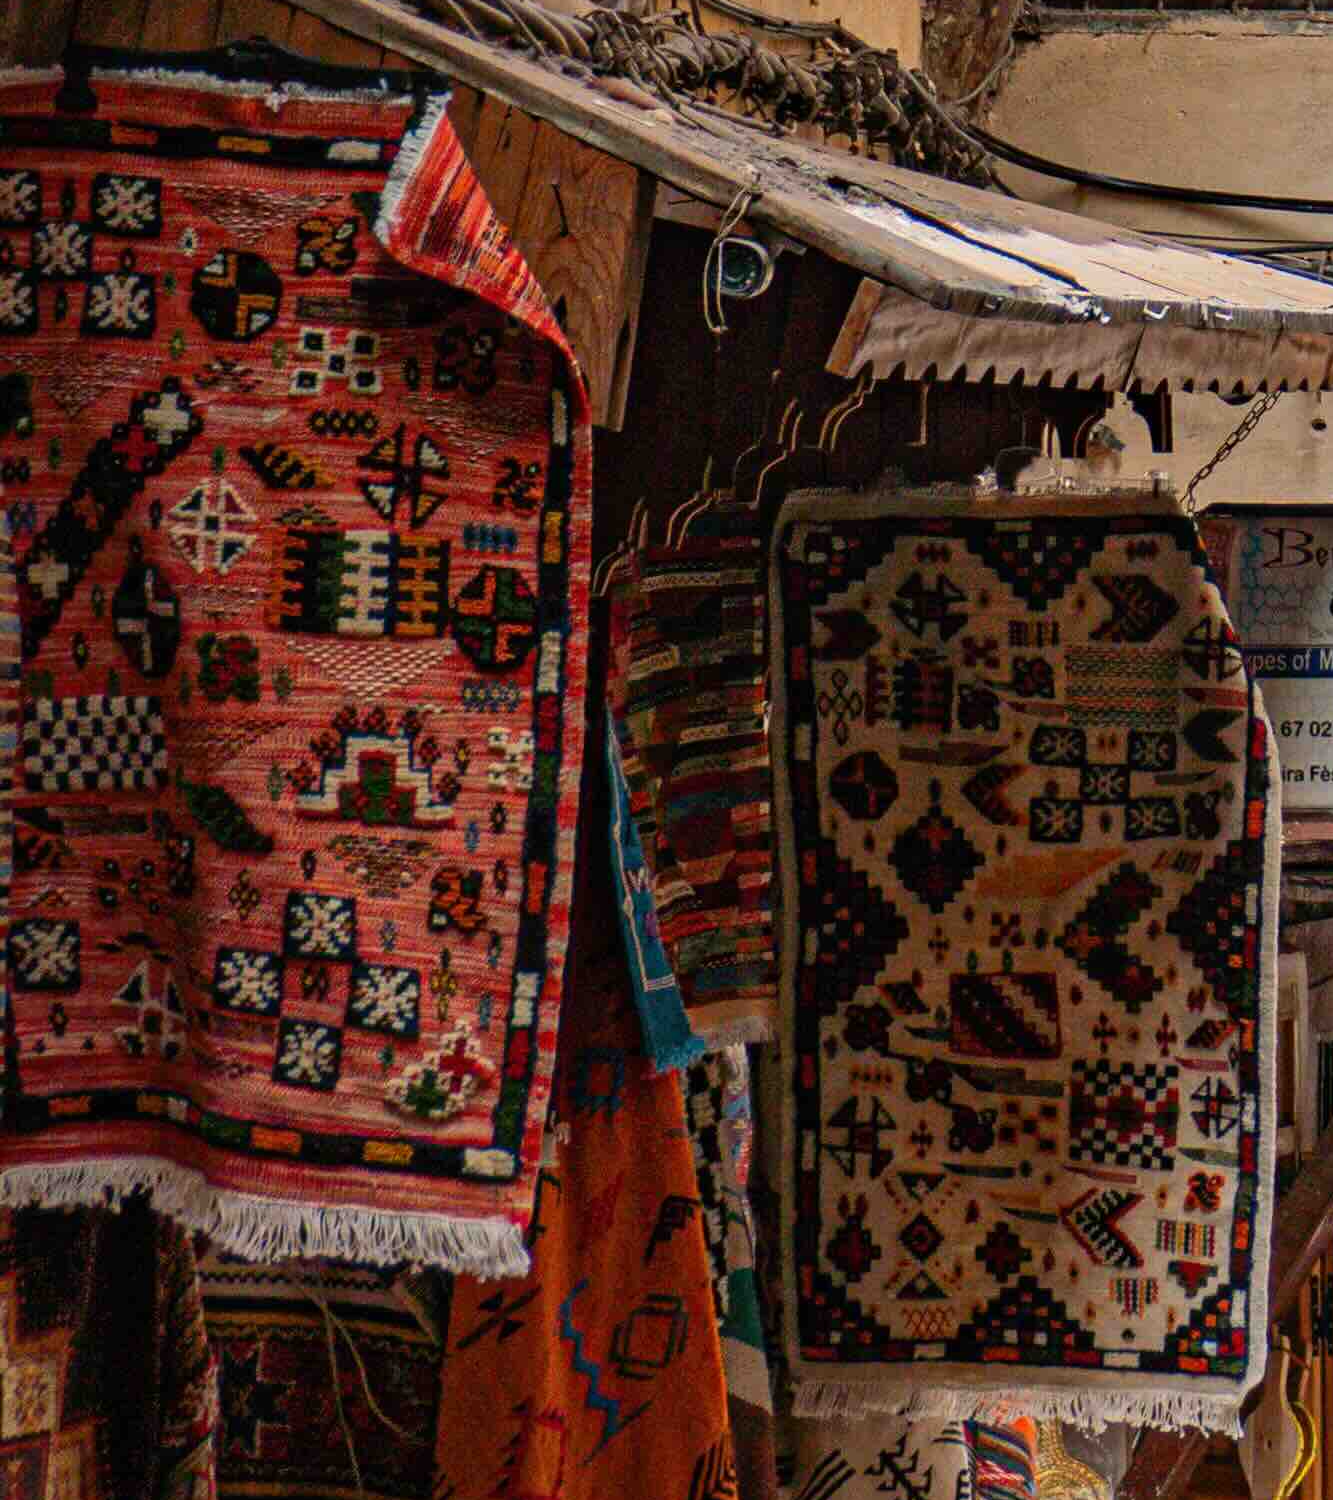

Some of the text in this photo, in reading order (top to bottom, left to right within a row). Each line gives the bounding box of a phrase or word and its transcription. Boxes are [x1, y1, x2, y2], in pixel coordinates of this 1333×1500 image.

[1292, 648, 1312, 671] of
[1280, 721, 1303, 738] 67
[1309, 721, 1332, 738] 02
[1282, 766, 1304, 782] ira
